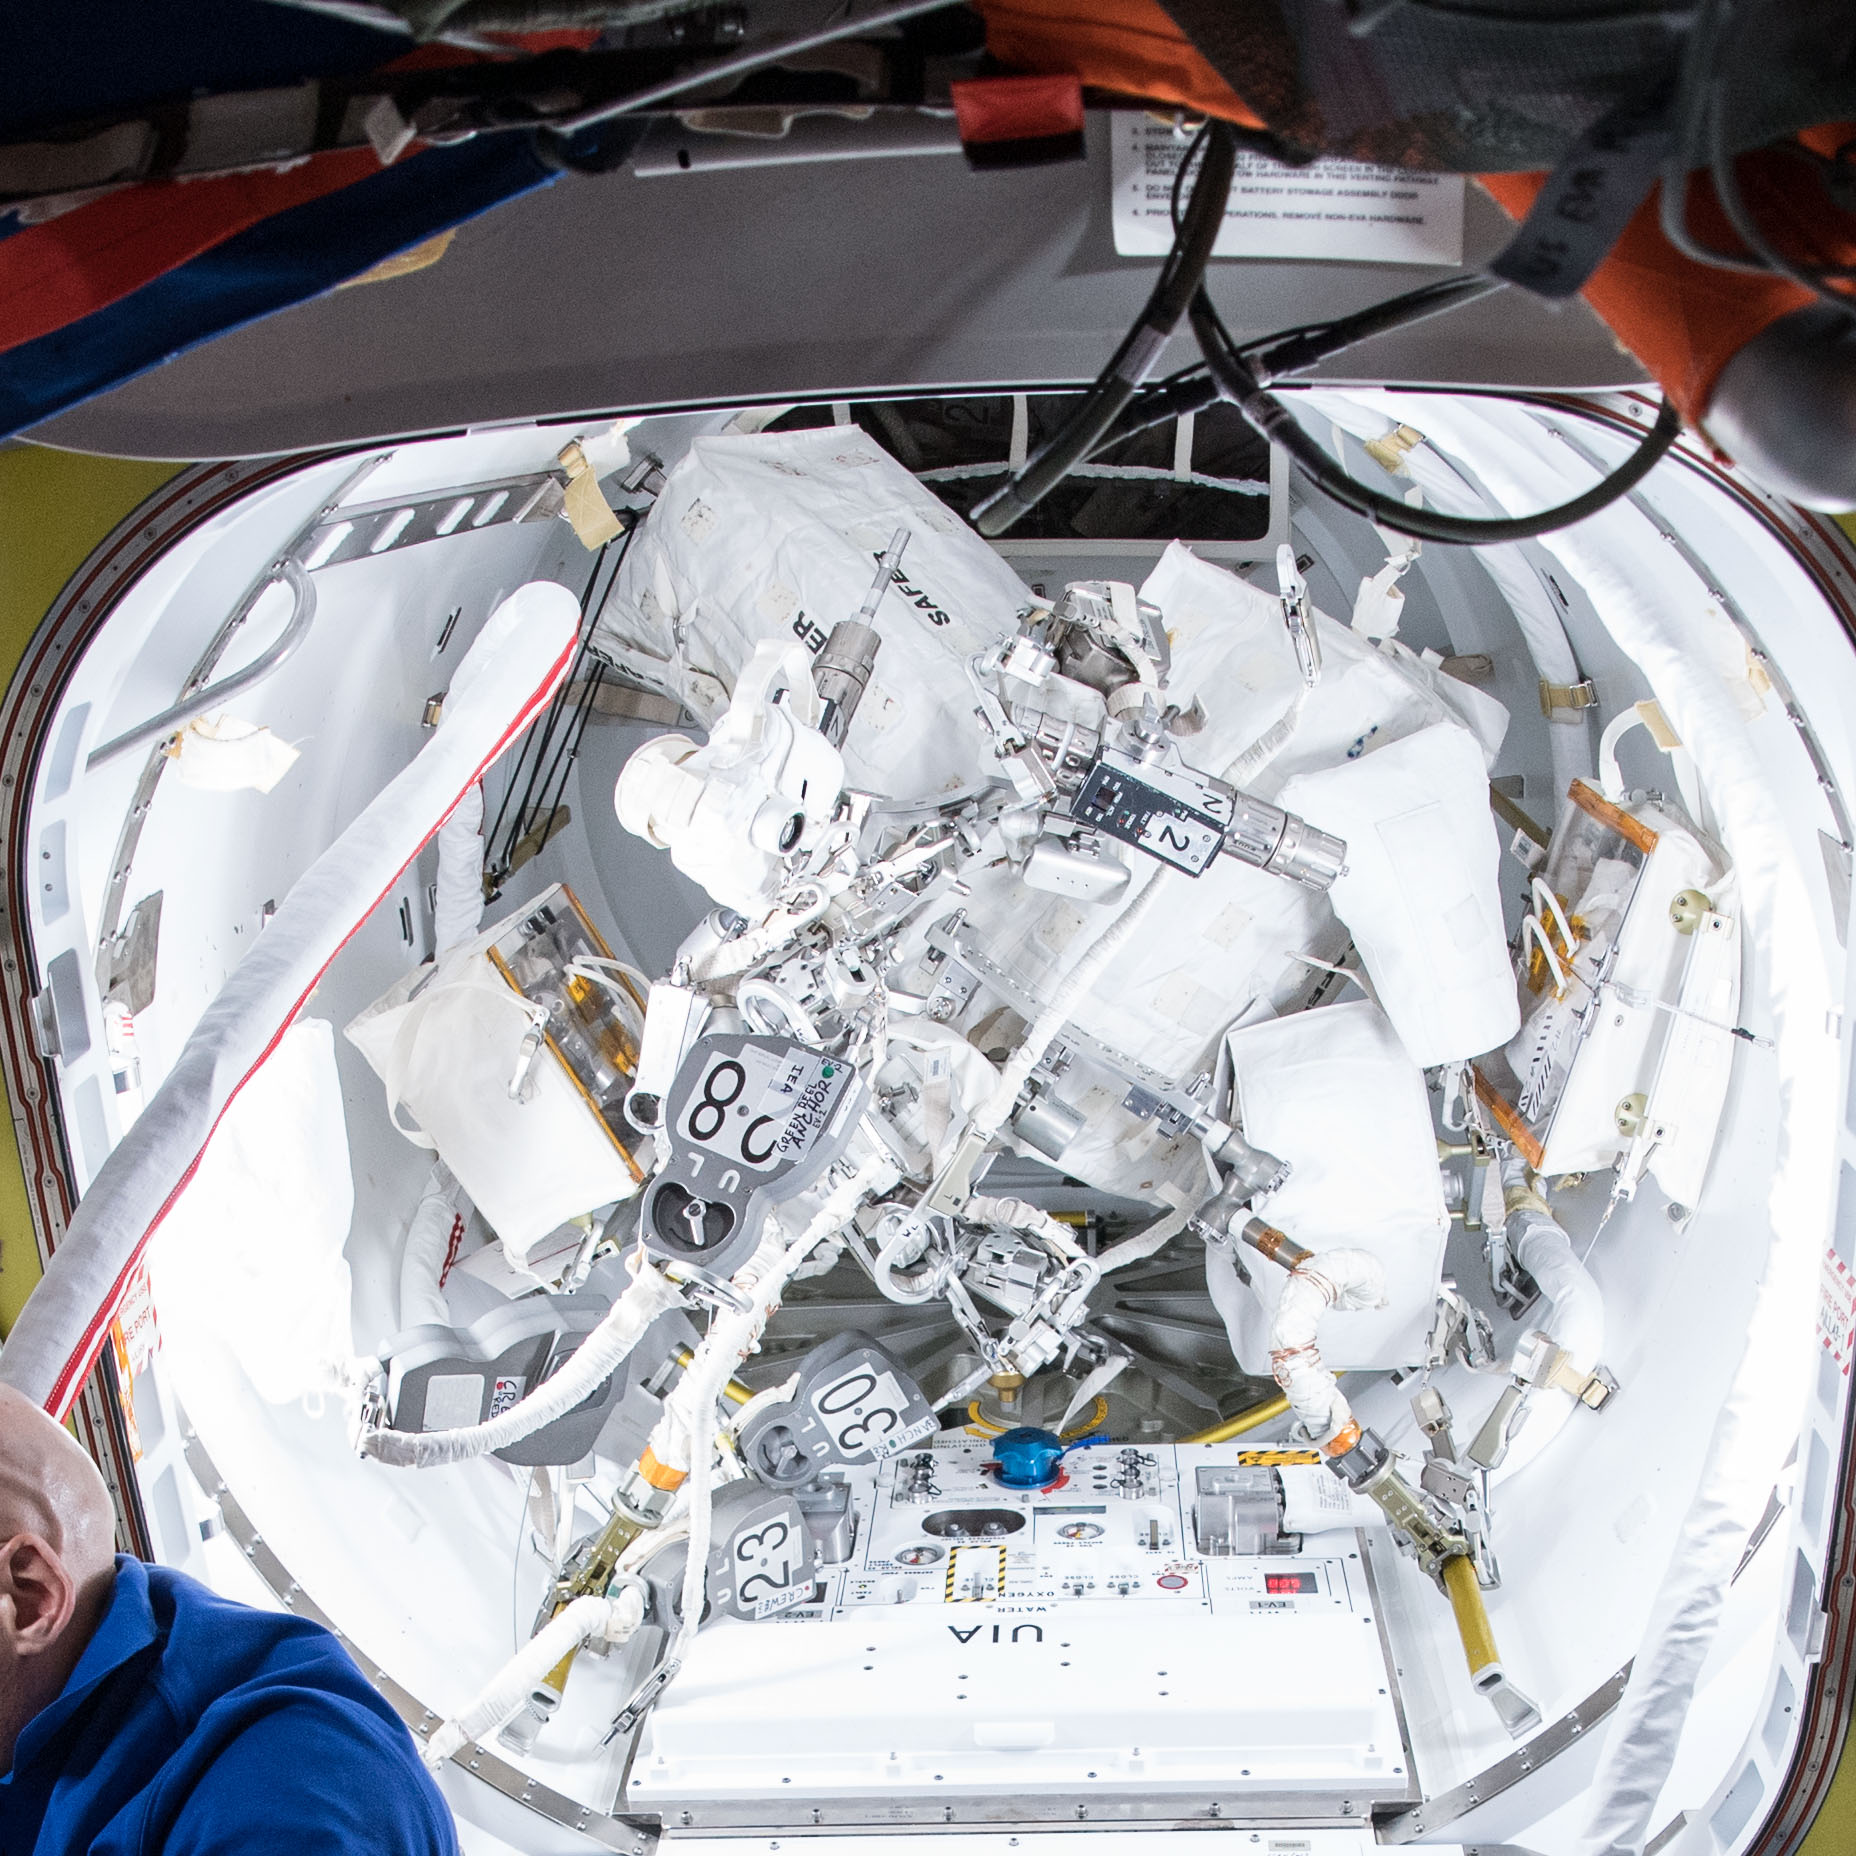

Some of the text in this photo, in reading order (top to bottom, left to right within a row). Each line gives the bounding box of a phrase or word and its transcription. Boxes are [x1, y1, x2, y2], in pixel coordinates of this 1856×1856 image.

[1159, 825, 1190, 851] 2
[780, 1064, 805, 1094] IEA
[777, 1082, 818, 1153] GREEN REEL
[793, 1078, 832, 1150] ANCHOR
[811, 1109, 827, 1129] EV-2
[997, 1590, 1055, 1598] OXYGEN
[995, 1605, 1047, 1613] WATER
[949, 1623, 1044, 1645] UIA
